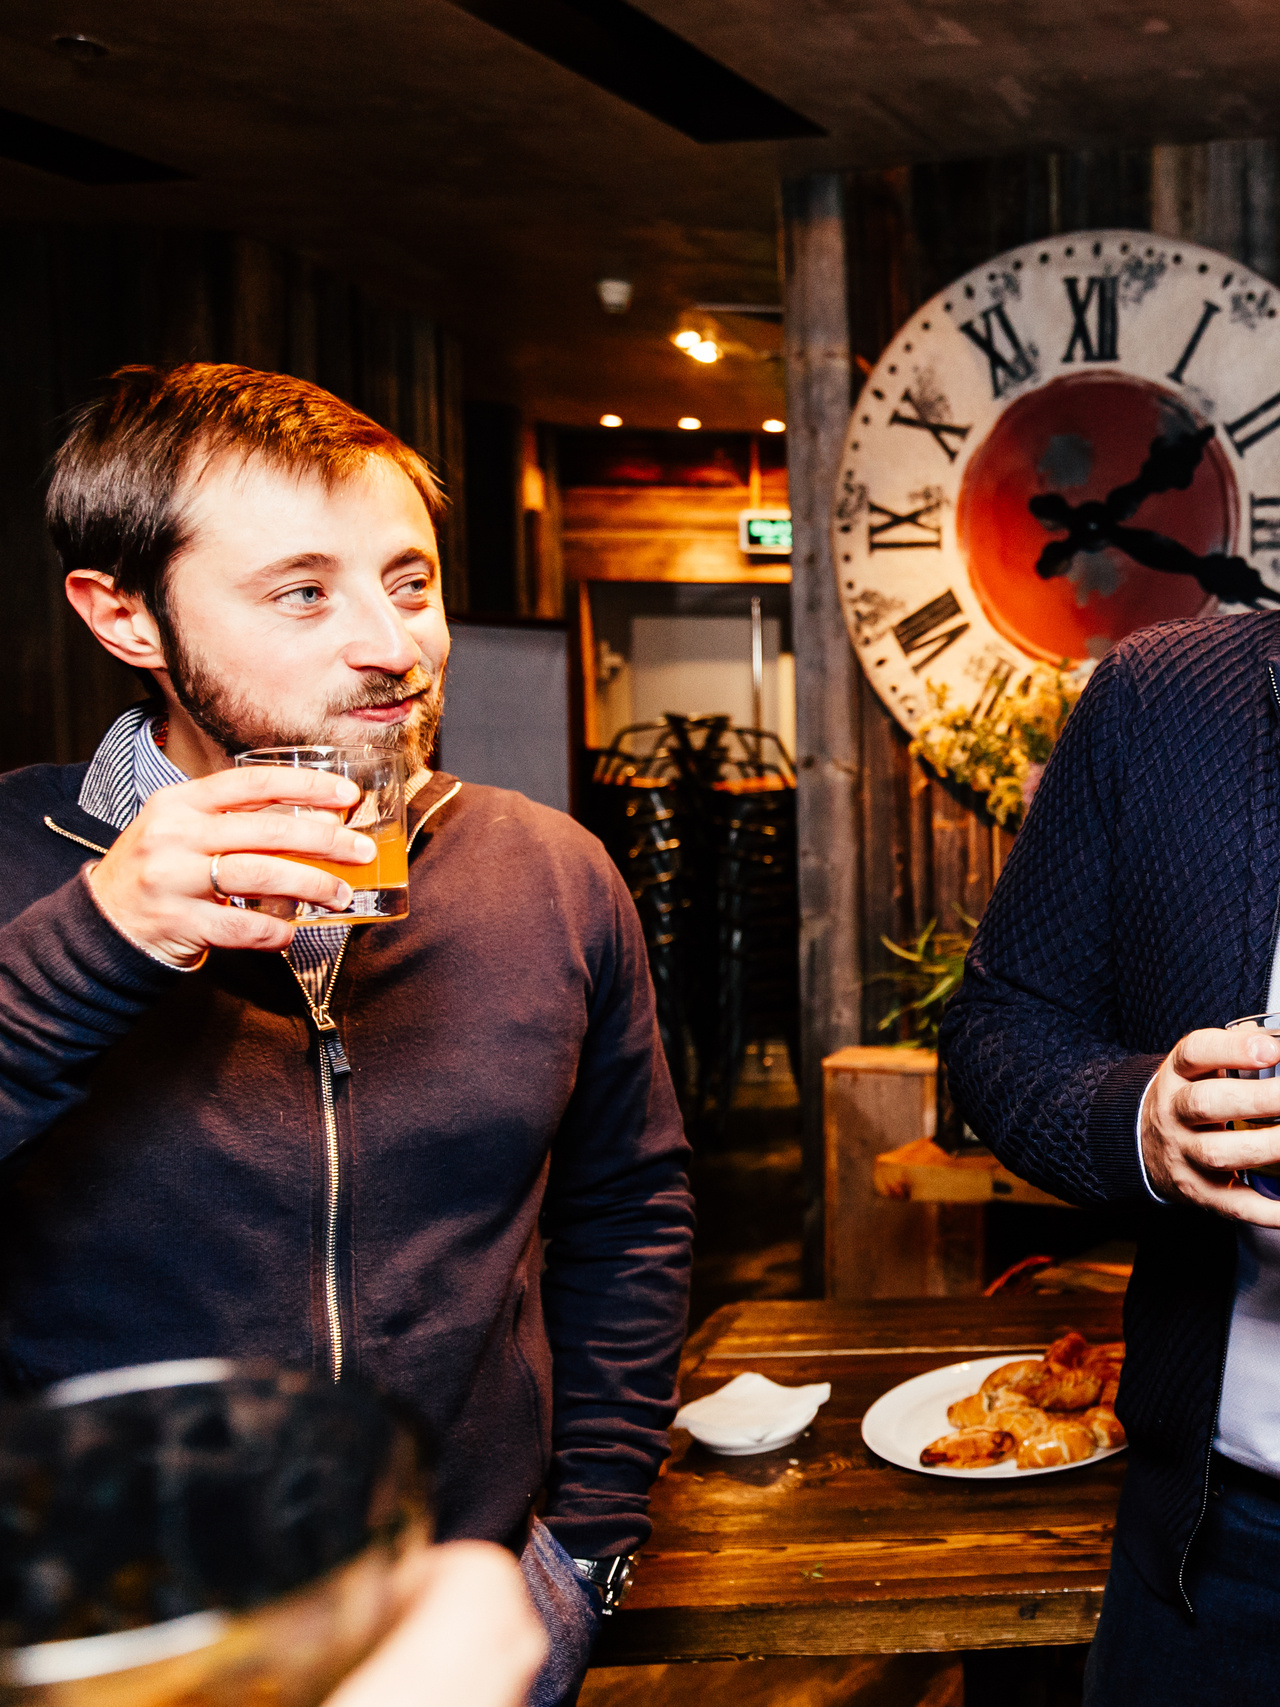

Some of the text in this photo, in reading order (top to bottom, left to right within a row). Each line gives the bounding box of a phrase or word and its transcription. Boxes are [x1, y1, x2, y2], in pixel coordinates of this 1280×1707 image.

[960, 302, 1034, 398] XI
[1062, 277, 1120, 363] XII
[1168, 301, 1222, 384] I
[889, 390, 972, 463] X
[868, 501, 942, 555] IX
